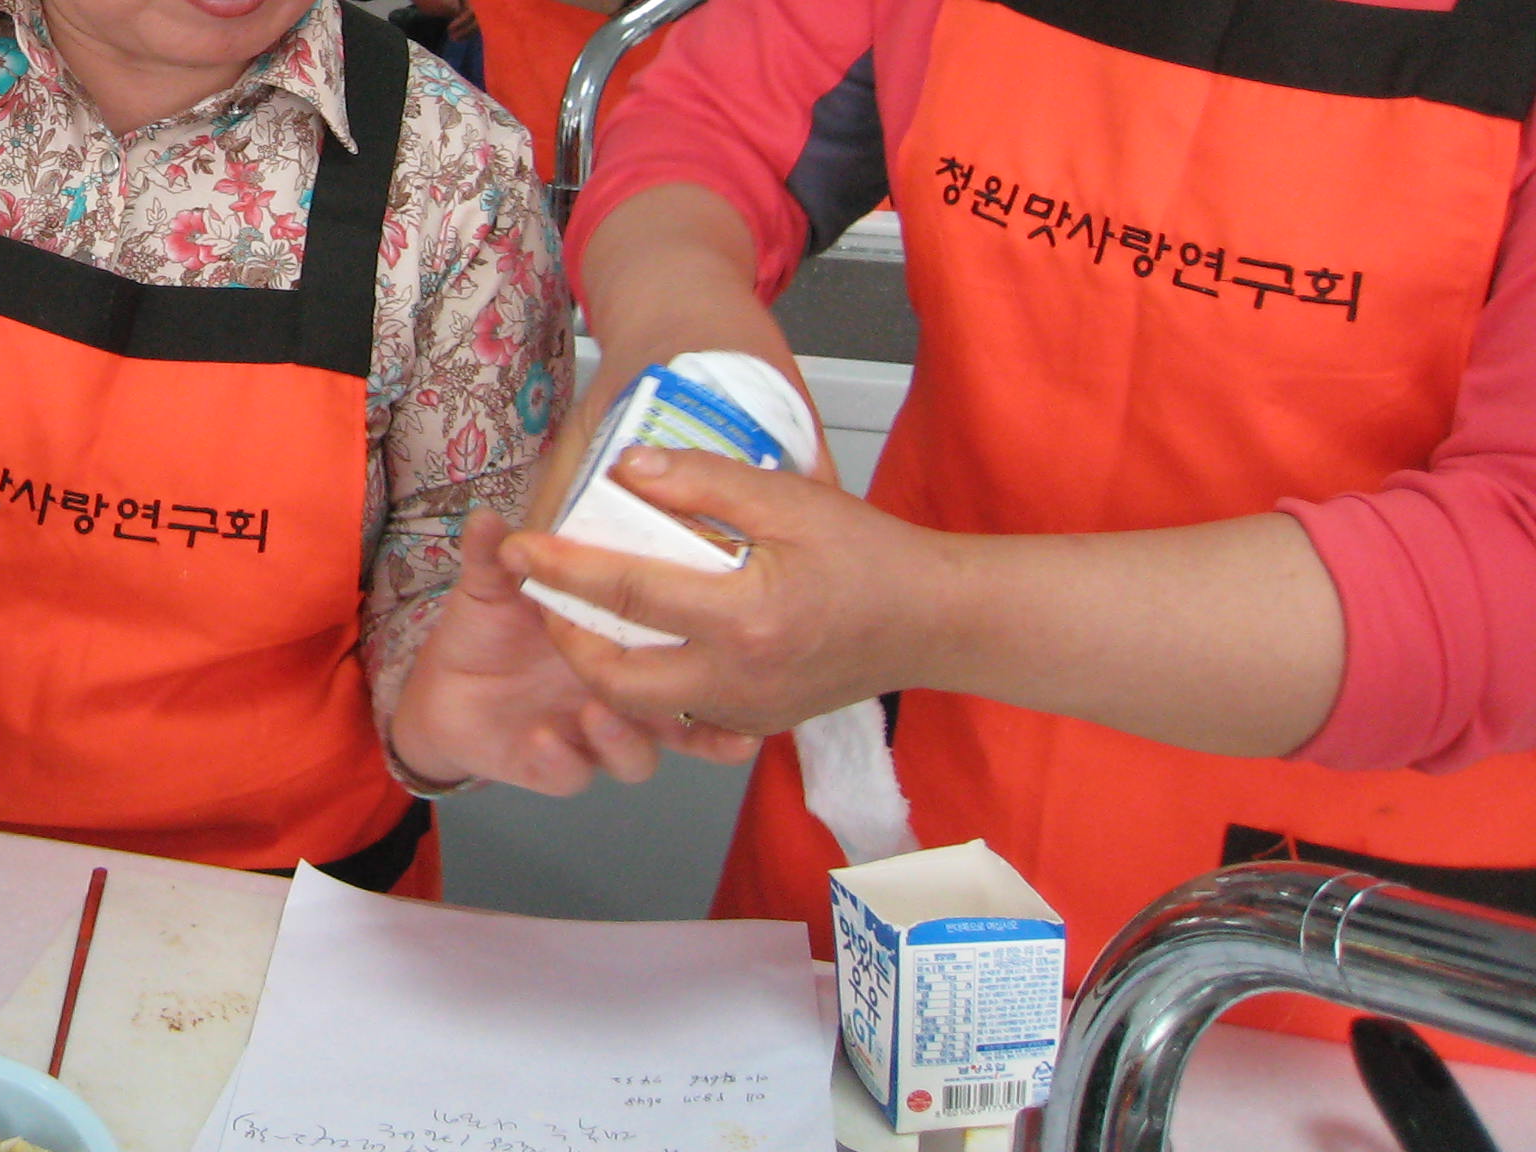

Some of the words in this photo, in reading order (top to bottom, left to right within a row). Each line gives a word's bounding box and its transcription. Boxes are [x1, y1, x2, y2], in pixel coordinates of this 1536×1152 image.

[935, 155, 1363, 323] 청원맛사랑연구회
[839, 915, 890, 998] 맛있는
[848, 965, 882, 1027] 우유
[852, 1008, 876, 1053] GT
